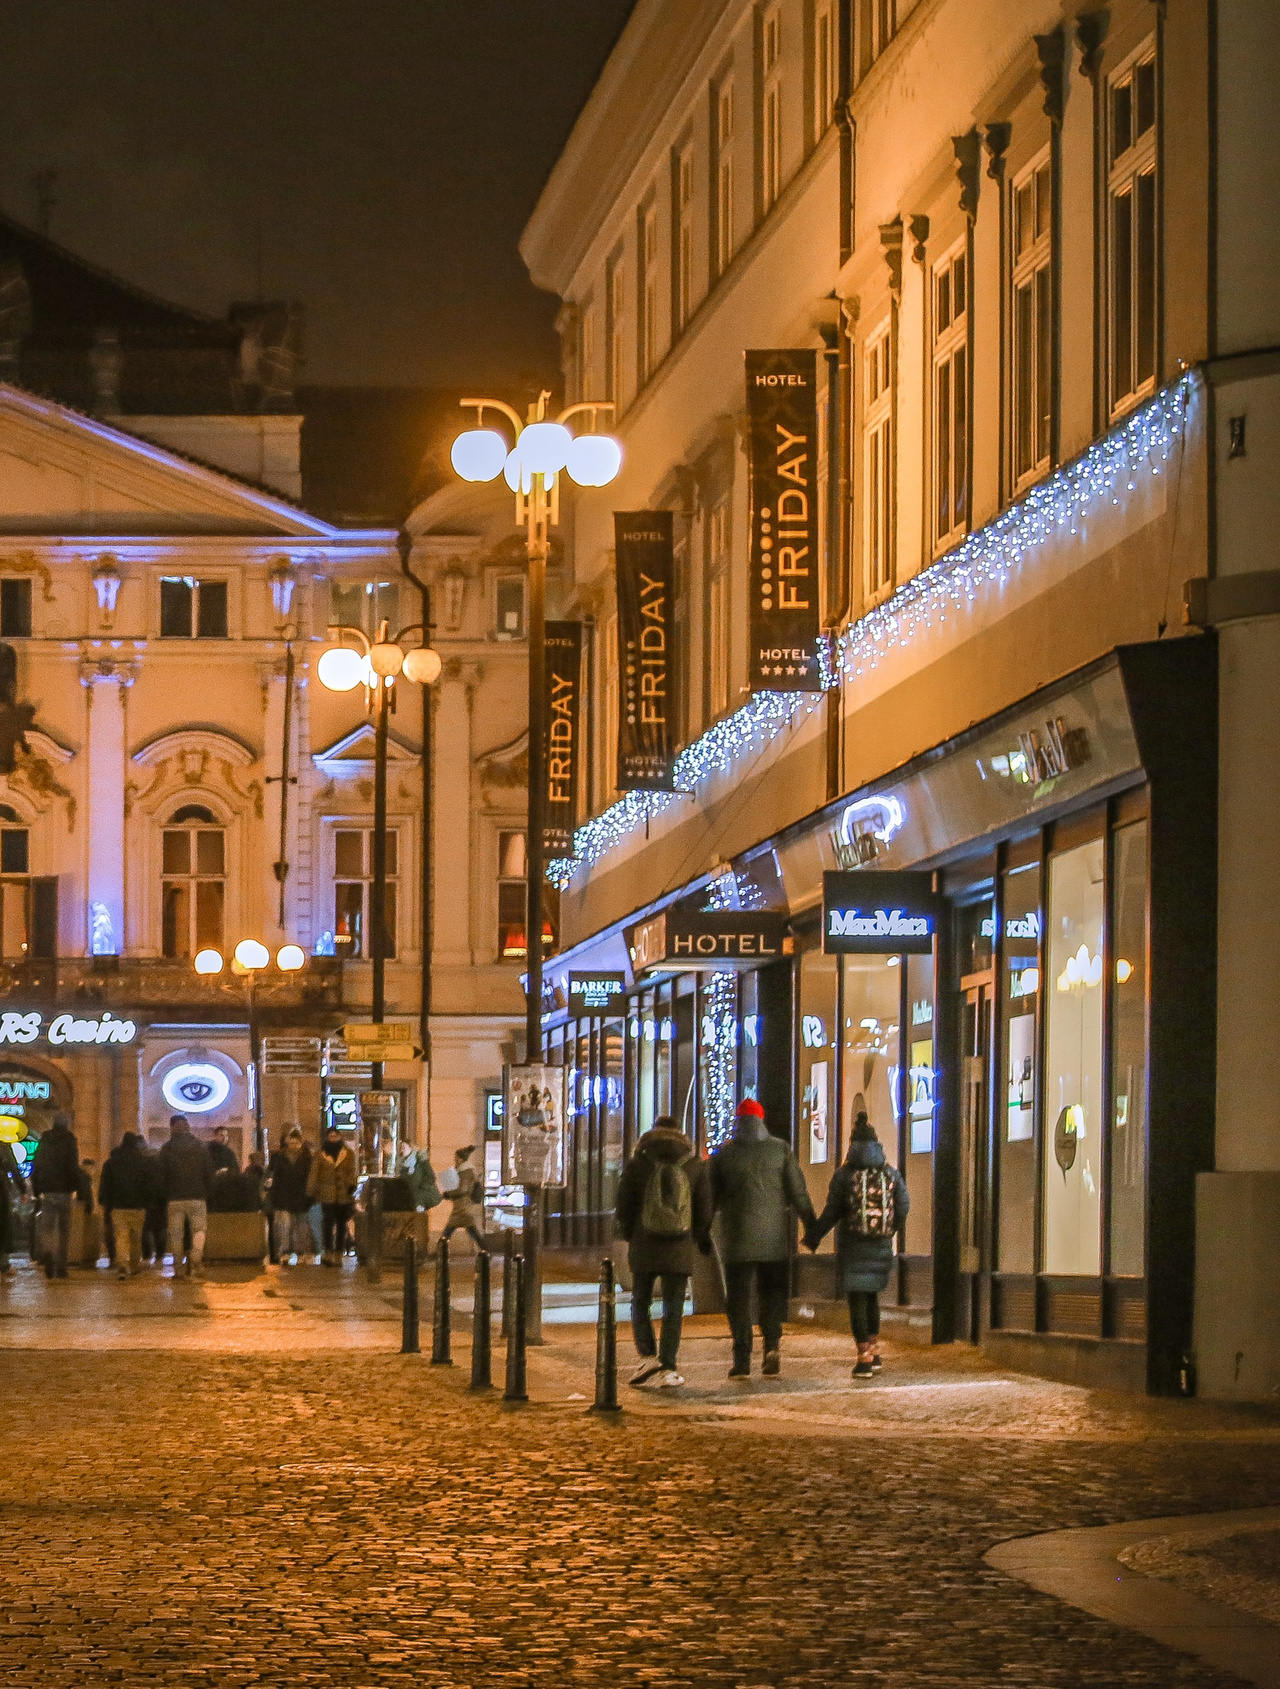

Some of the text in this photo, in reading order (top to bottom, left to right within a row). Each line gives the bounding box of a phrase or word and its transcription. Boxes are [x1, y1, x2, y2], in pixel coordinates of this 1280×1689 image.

[756, 374, 807, 387] HOTEL
[776, 423, 810, 610] FRIDAY
[623, 531, 665, 541] HOTEL
[546, 638, 575, 647] OTEL
[640, 572, 666, 724] FRIDAY
[760, 648, 812, 662] HOTEL
[549, 672, 573, 803] FRIDAY
[624, 755, 668, 767] HOTEL
[543, 828, 570, 837] OTEL
[828, 909, 928, 937] MaxMara
[674, 934, 776, 954] HOTEL
[570, 980, 623, 994] BARKER
[48, 1011, 136, 1045] Casino
